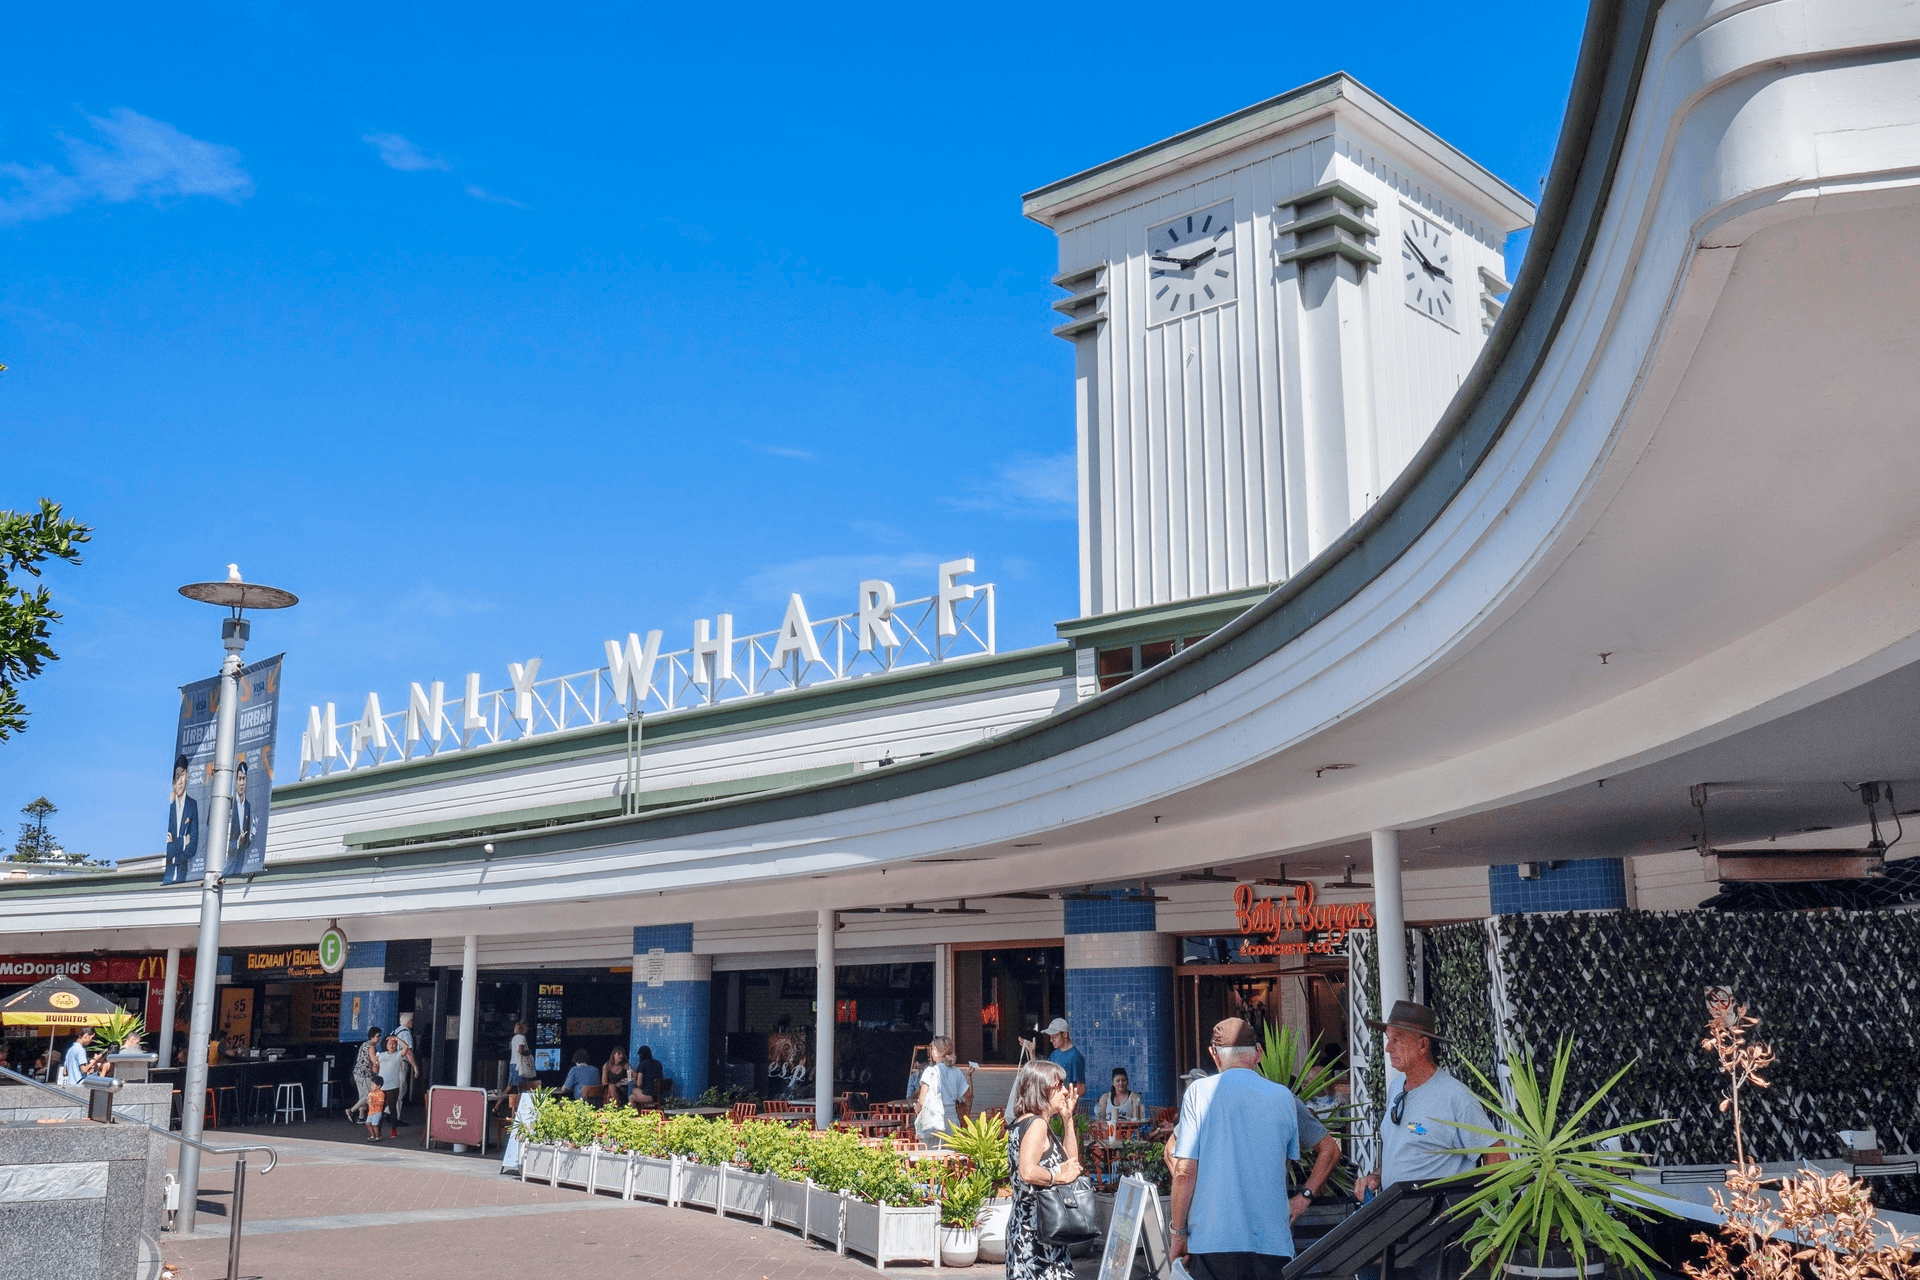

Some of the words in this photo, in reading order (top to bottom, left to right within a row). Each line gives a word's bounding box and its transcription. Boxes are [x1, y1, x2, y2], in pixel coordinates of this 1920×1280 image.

[301, 657, 542, 763] MANLY
[604, 558, 976, 705] WHARF
[240, 705, 273, 730] URBAN
[182, 724, 217, 745] URBAN
[239, 723, 271, 740] SURVIVALIST
[181, 741, 216, 755] SURVIVALIST
[1233, 883, 1295, 943] Betty's
[1294, 881, 1374, 943] Burgers
[327, 940, 336, 962] F
[1248, 942, 1311, 956] CONCRETE
[247, 952, 286, 969] GUZMAN
[286, 951, 293, 967] Y
[293, 948, 320, 967] GOME
[0, 961, 91, 975] McDonald's
[313, 989, 341, 1001] TACOS
[234, 998, 247, 1012] $5
[45, 1014, 88, 1023] BURRITOS
